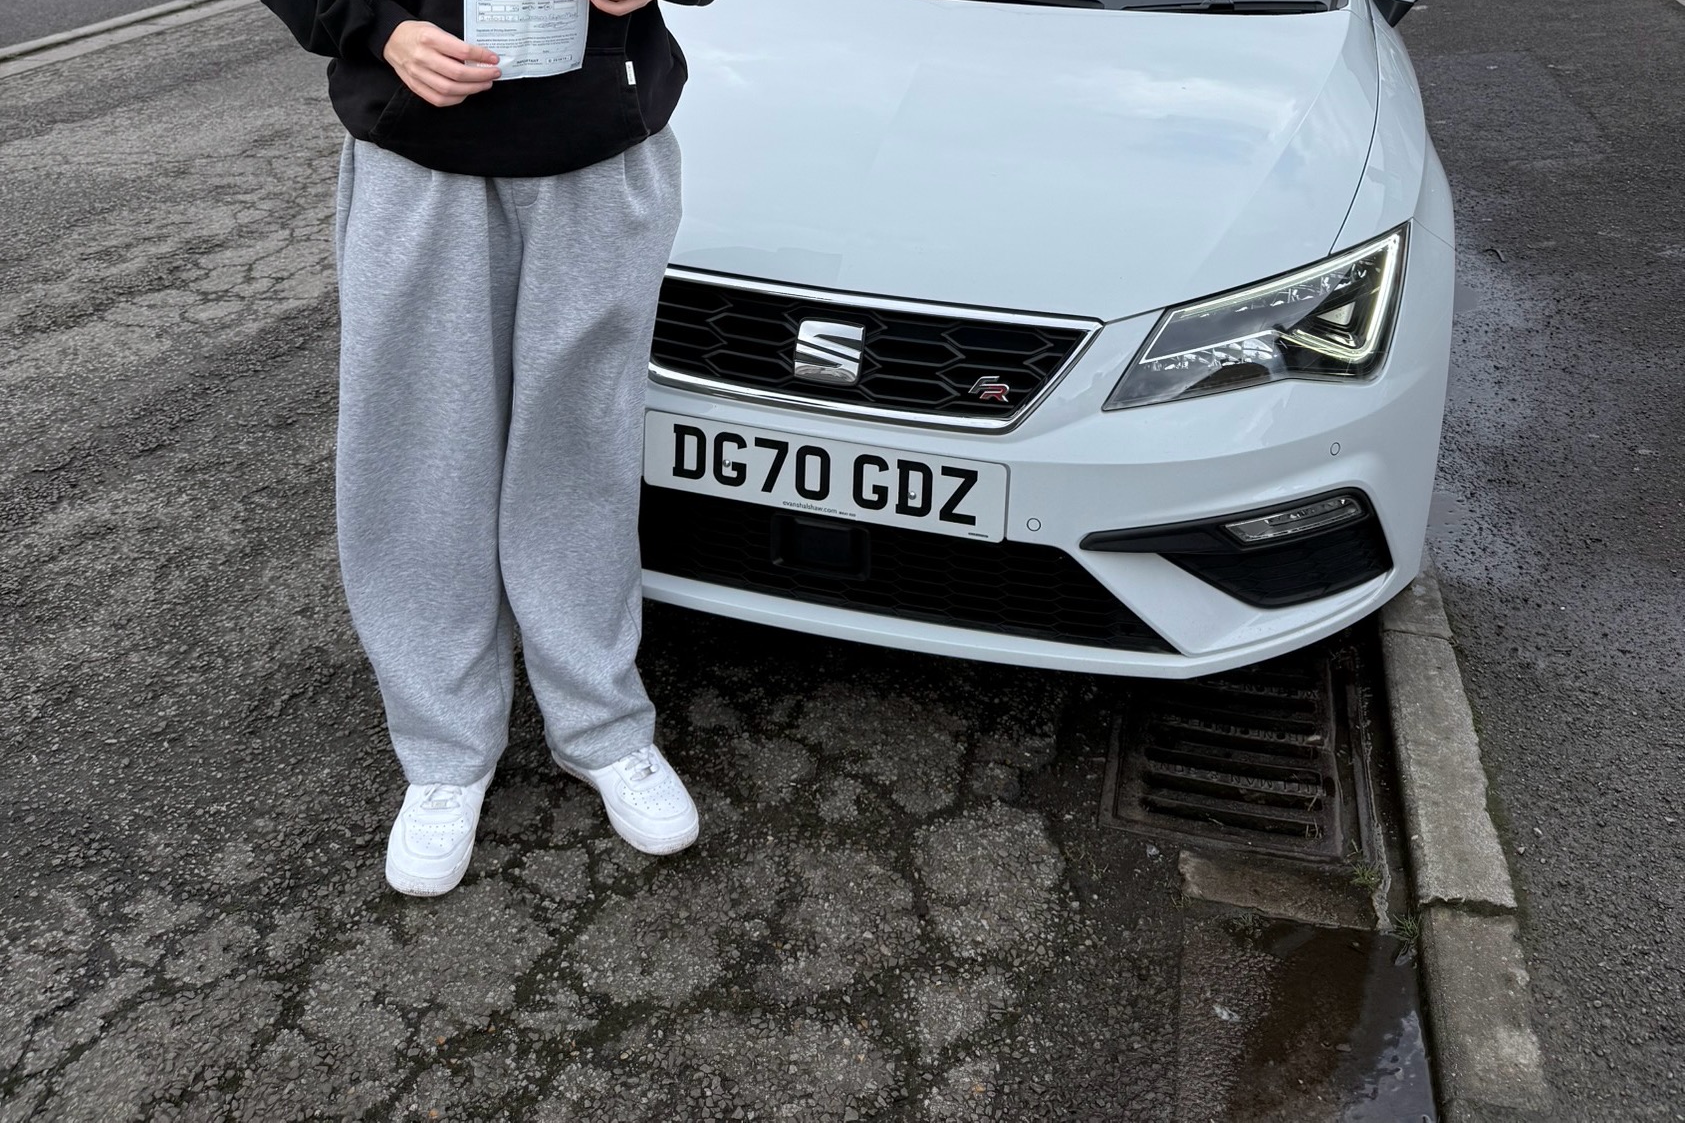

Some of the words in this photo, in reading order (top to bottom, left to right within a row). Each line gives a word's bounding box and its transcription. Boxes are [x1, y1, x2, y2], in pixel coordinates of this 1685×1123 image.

[672, 423, 830, 501] DG70
[852, 454, 979, 526] GDZ
[782, 500, 837, 514] evanshalshaw.com
